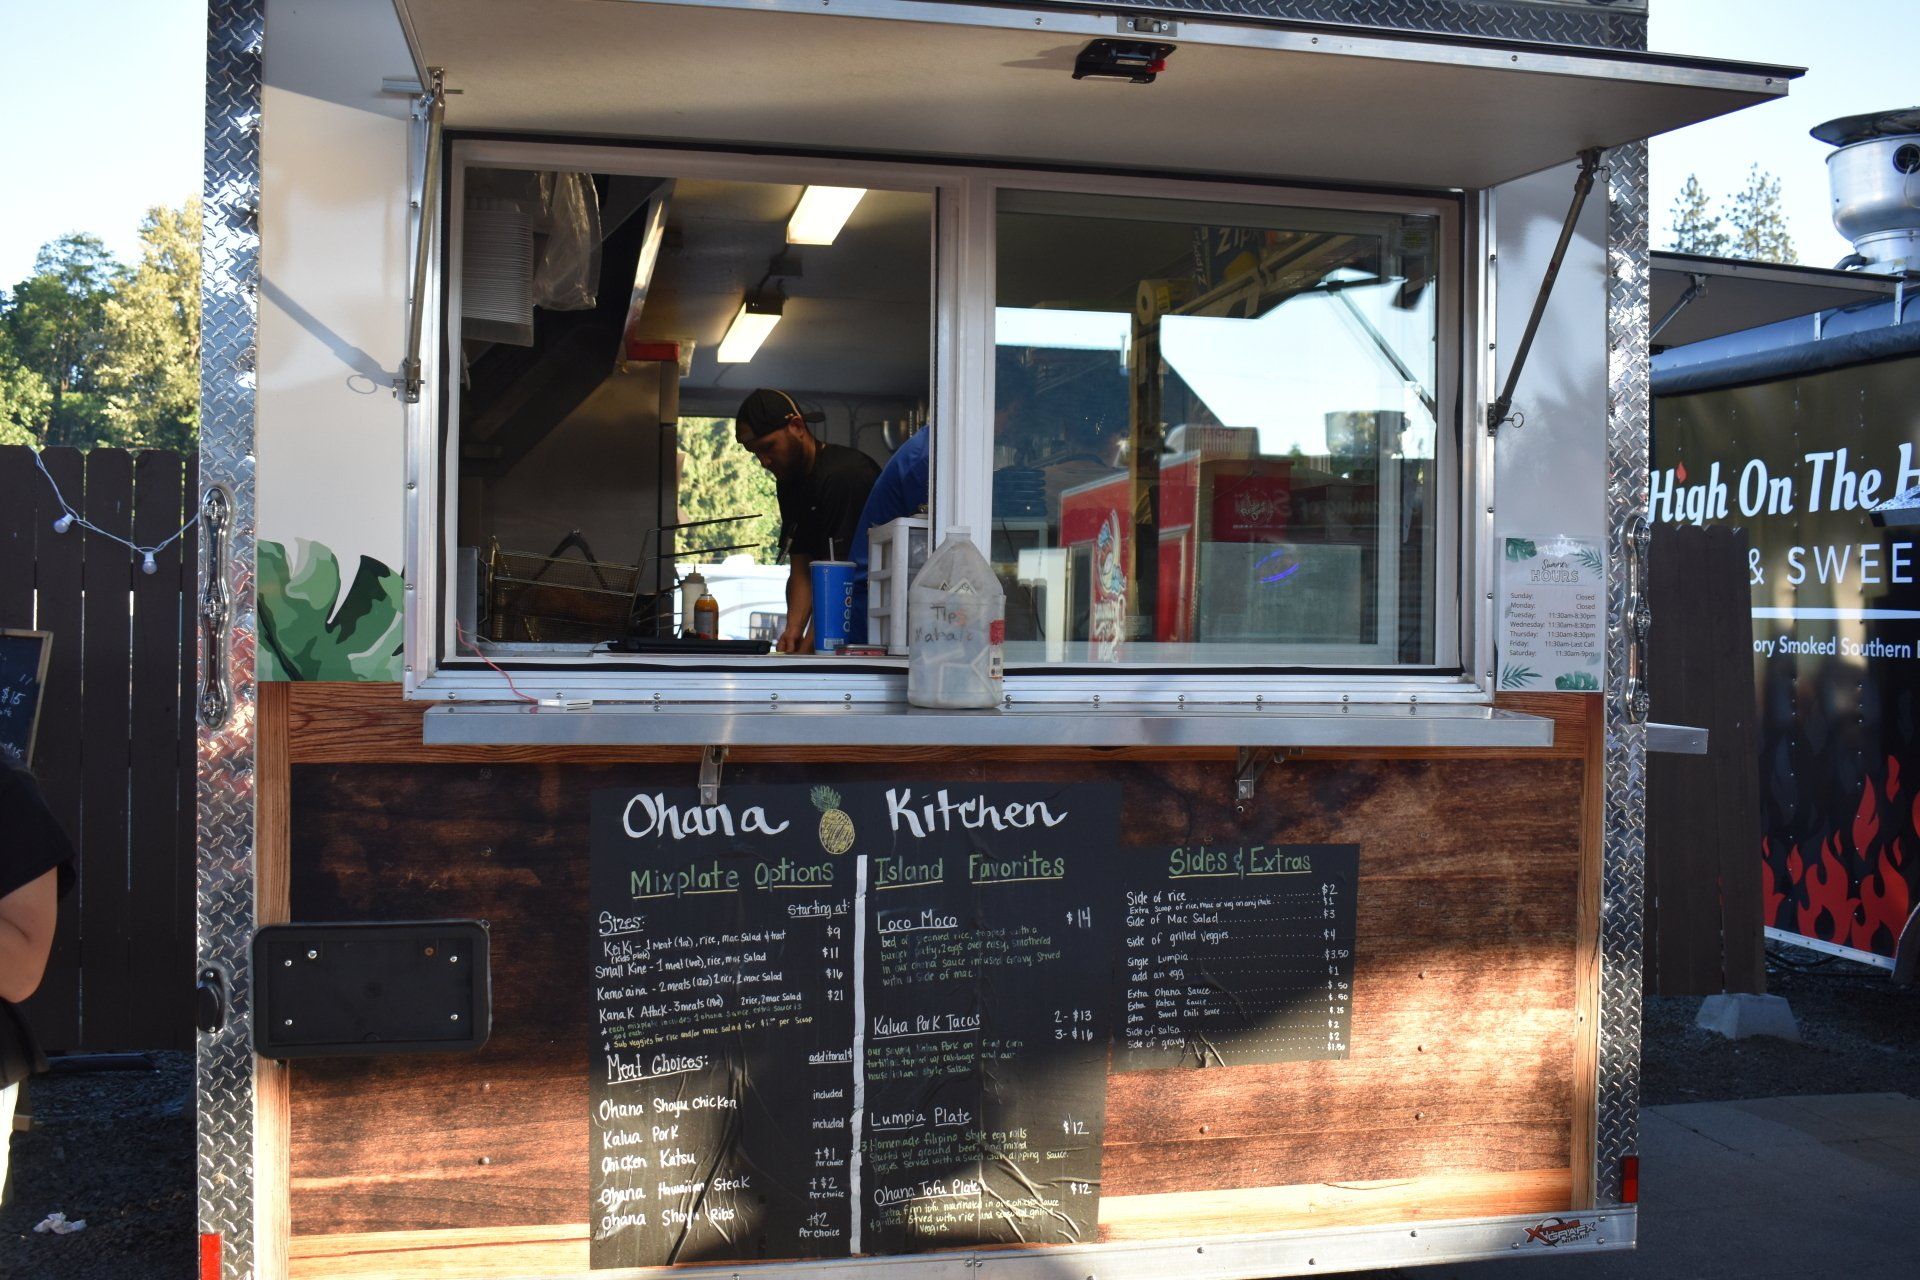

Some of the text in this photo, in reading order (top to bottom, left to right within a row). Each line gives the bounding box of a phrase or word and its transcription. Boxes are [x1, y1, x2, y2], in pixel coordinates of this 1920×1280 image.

[1649, 462, 1728, 526] High
[1739, 459, 1794, 517] On
[1804, 448, 1882, 513] The
[1749, 542, 1912, 585] & SWEE
[1531, 570, 1579, 583] HOURS
[1510, 592, 1534, 600] Sunday:
[1510, 602, 1536, 610] Monday:
[1510, 611, 1536, 619] Tuesday:
[1509, 649, 1536, 657] Saturday:
[1779, 635, 1835, 656] Smoked
[1840, 636, 1911, 658] Southern
[623, 788, 1069, 839] Ohana Kitchen
[1168, 847, 1227, 875] Sides
[1250, 846, 1311, 873] Extras
[874, 850, 1065, 886] Island Favorites
[631, 857, 834, 898] Mixplate Options
[1322, 883, 1338, 896] $2
[1127, 890, 1186, 906] Side of rice
[1323, 896, 1334, 905] $1
[788, 900, 831, 919] Starting
[1130, 907, 1149, 915] Extra
[1176, 902, 1183, 910] of
[1323, 908, 1336, 919] $3
[599, 911, 645, 935] Sizes:
[877, 908, 958, 932] Loco Moco
[1066, 906, 1091, 928] $14
[1127, 912, 1218, 927] Side of Mac Salad
[827, 925, 841, 939] $9
[1127, 936, 1144, 947] Side
[1152, 932, 1163, 945] of
[1170, 930, 1196, 947] grilled
[1324, 928, 1336, 941] $4
[822, 947, 838, 958] $11
[1325, 949, 1348, 960] $3.50
[1128, 951, 1188, 970] Single Lumpia
[595, 964, 623, 978] Small
[628, 962, 647, 975] Kine
[825, 968, 843, 979] $16
[1132, 970, 1148, 982] add
[1169, 969, 1184, 980] egg
[1328, 965, 1339, 976] $1
[827, 989, 843, 1001] $21
[1128, 987, 1211, 998] Extra Ohana Sauce
[1073, 1009, 1092, 1022] $13
[874, 1013, 980, 1035] Kalua Pork Tacos
[1126, 1025, 1180, 1037] Side of salsa
[1328, 1019, 1339, 1029] $2
[1128, 1037, 1185, 1050] Side of gravy
[1329, 1032, 1340, 1041] $2
[607, 1054, 642, 1080] Meat
[813, 1089, 843, 1100] included
[600, 1099, 643, 1120] Ohana
[653, 1098, 690, 1118] Shoyu
[813, 1117, 844, 1129] included
[871, 1107, 972, 1126] Lumpia Plate
[1063, 1121, 1089, 1135] $12
[603, 1124, 678, 1149] Kalua Pork
[601, 1148, 696, 1175] Chicken Katsu
[600, 1187, 646, 1205] Ohana
[714, 1175, 750, 1191] Steak
[874, 1179, 980, 1205] Ohana Tofu Plate
[1070, 1182, 1092, 1195] $12
[602, 1213, 646, 1230] Ohana
[710, 1207, 735, 1220] Ribs
